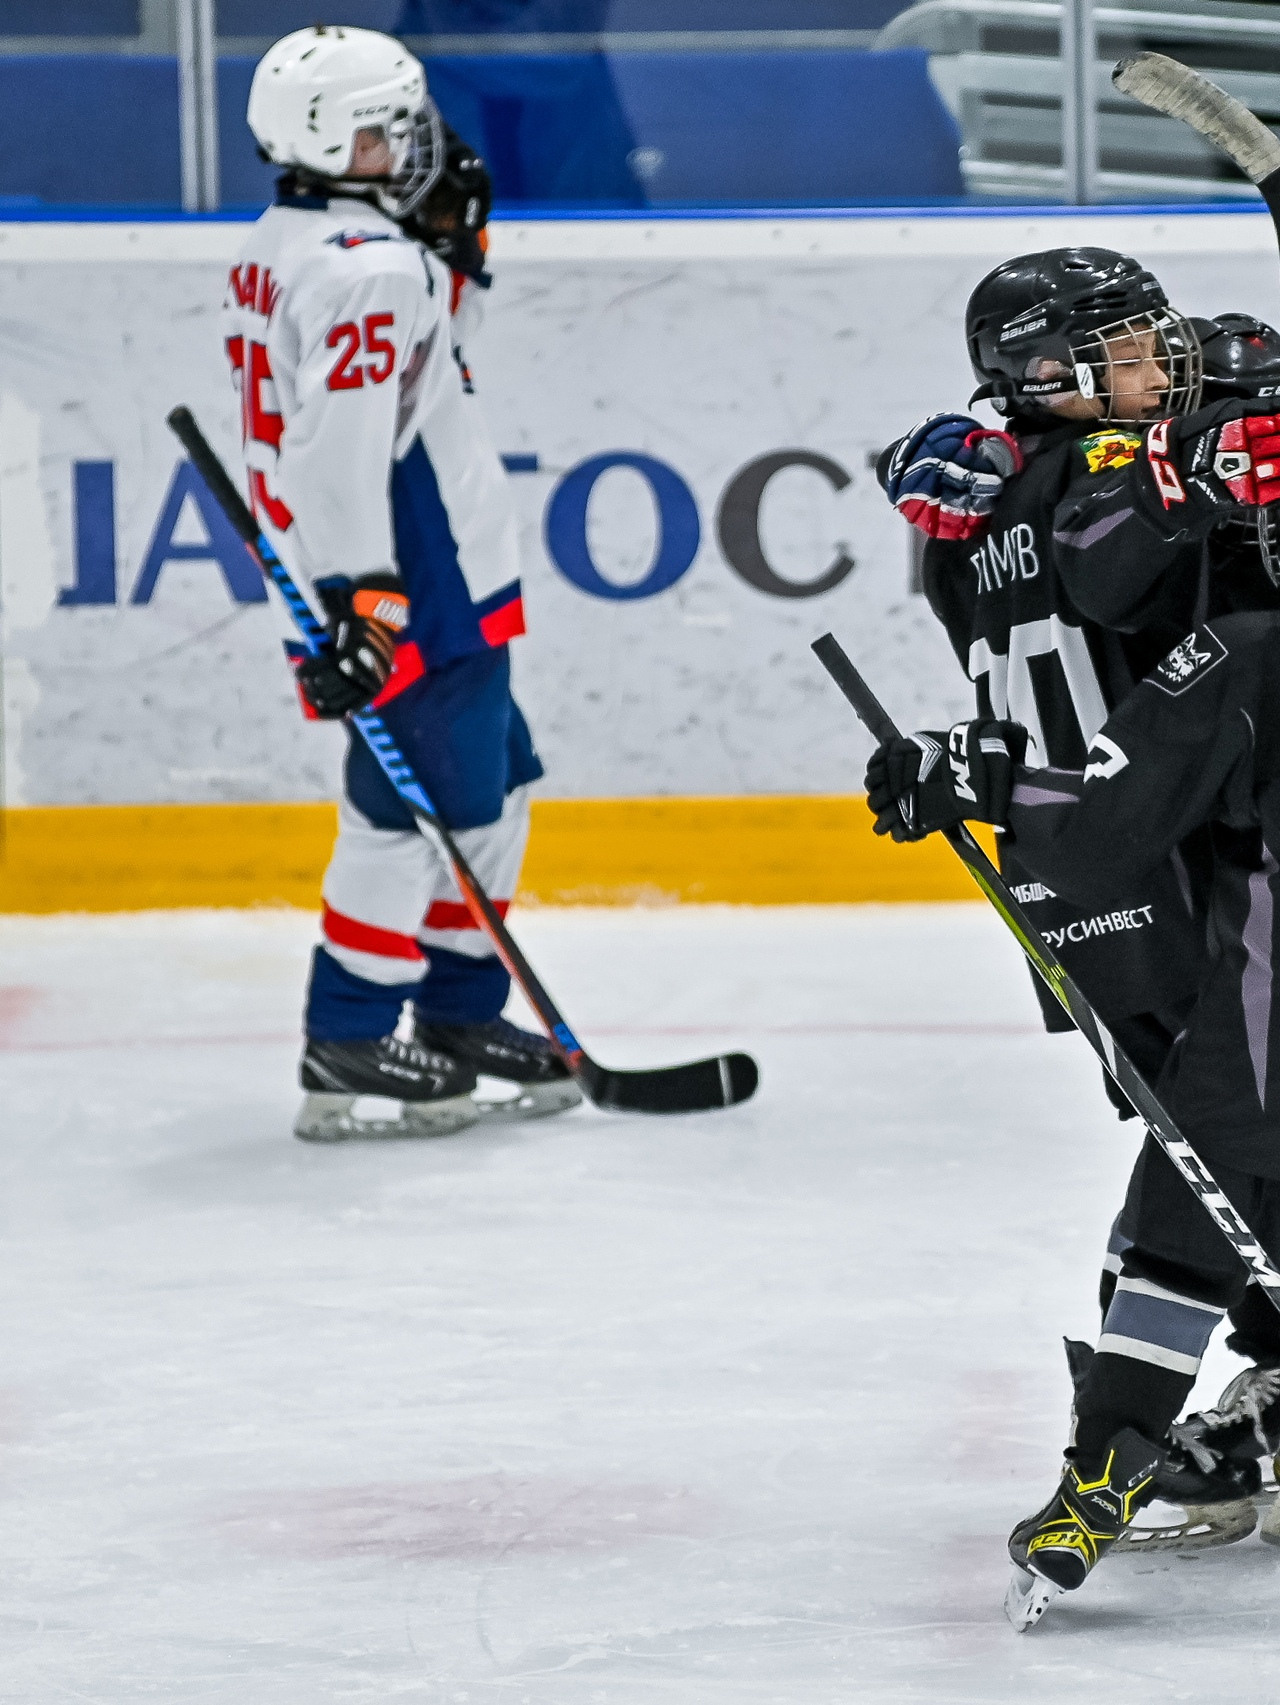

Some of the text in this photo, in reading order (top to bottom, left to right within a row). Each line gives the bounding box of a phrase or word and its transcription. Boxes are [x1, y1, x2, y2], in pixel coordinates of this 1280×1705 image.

[324, 311, 397, 392] 25
[1000, 317, 1047, 342] BAUER
[1023, 381, 1062, 392] BAUER
[948, 723, 977, 803] CM
